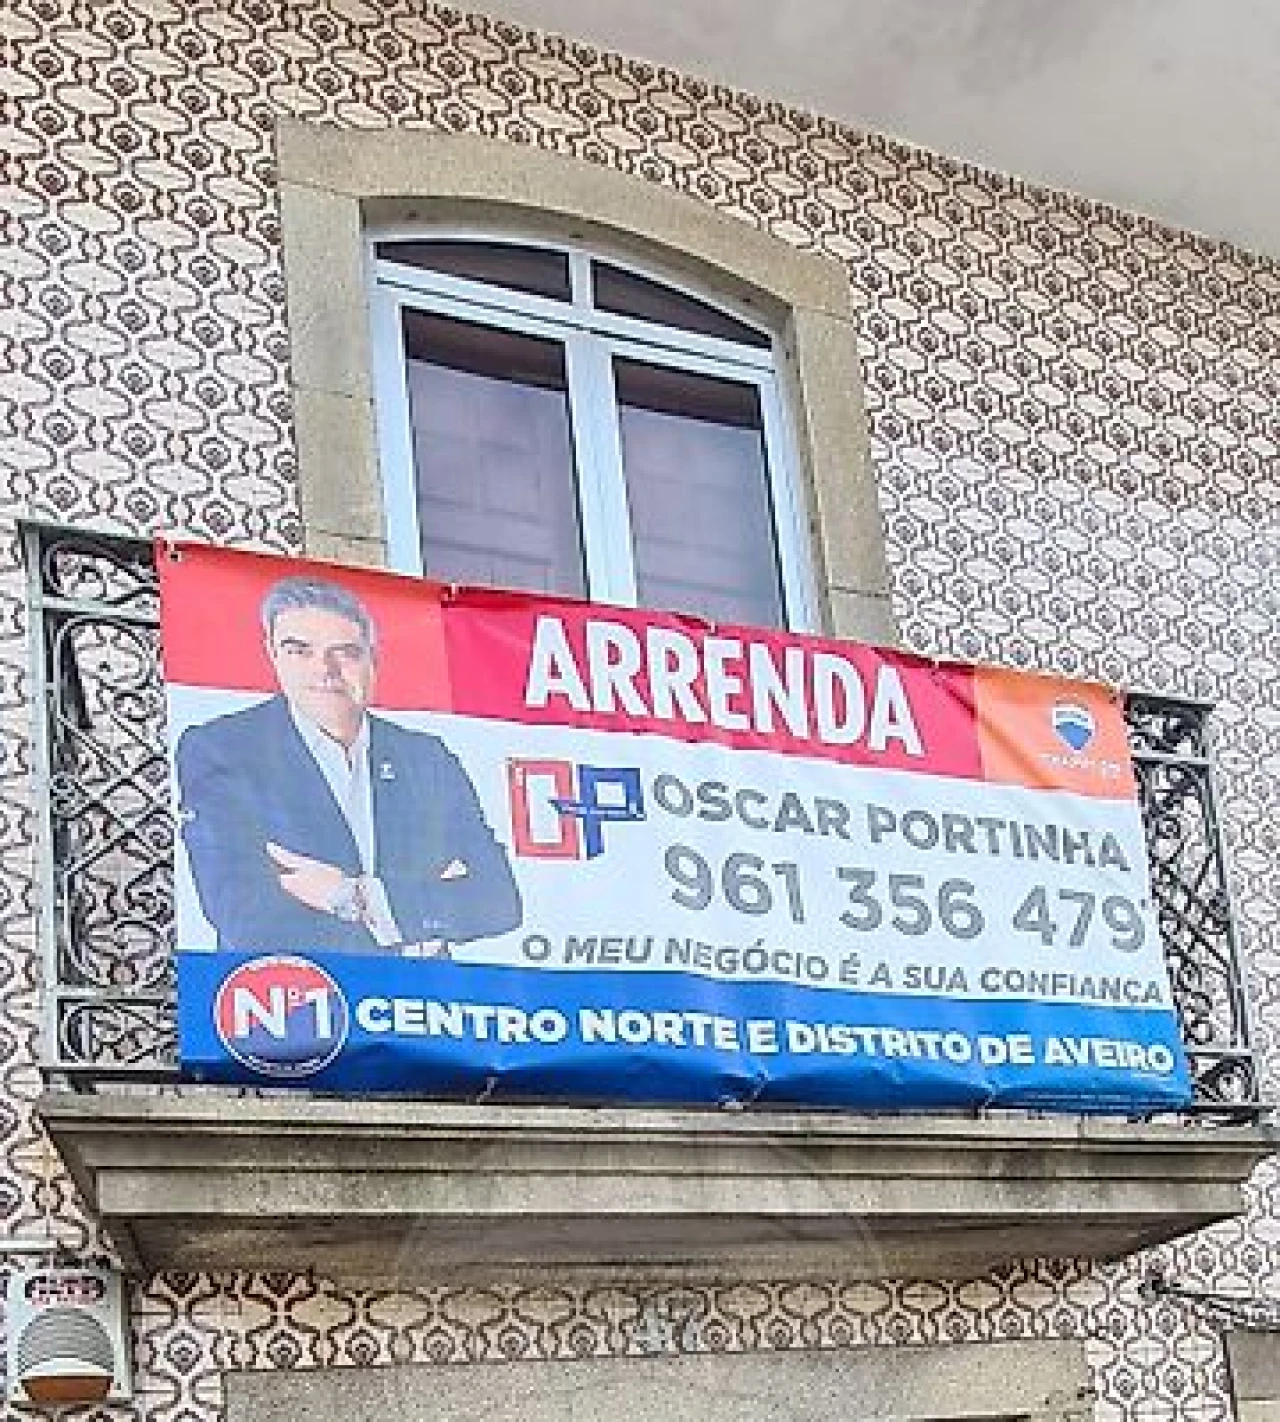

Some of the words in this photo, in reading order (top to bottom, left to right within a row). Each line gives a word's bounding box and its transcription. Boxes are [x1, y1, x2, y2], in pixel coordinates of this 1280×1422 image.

[525, 615, 924, 755] ARRENDA
[653, 774, 851, 840] OSCAR
[868, 804, 1132, 872] PORTINHA
[664, 843, 805, 924] 961
[837, 866, 986, 940] 356
[522, 934, 552, 961] O
[563, 935, 653, 964] MEU
[664, 937, 829, 980] NEGÓCIO
[839, 953, 861, 985] É
[868, 962, 894, 988] A
[903, 964, 968, 993] SUA
[980, 966, 1163, 1004] CONFIANÇA
[355, 998, 567, 1044] CENTRO
[581, 1006, 739, 1052] NORTE
[747, 1019, 776, 1054] E
[788, 1022, 973, 1064] DISTRITO
[979, 1033, 1035, 1065] DE
[1044, 1036, 1174, 1073] AVEIRO
